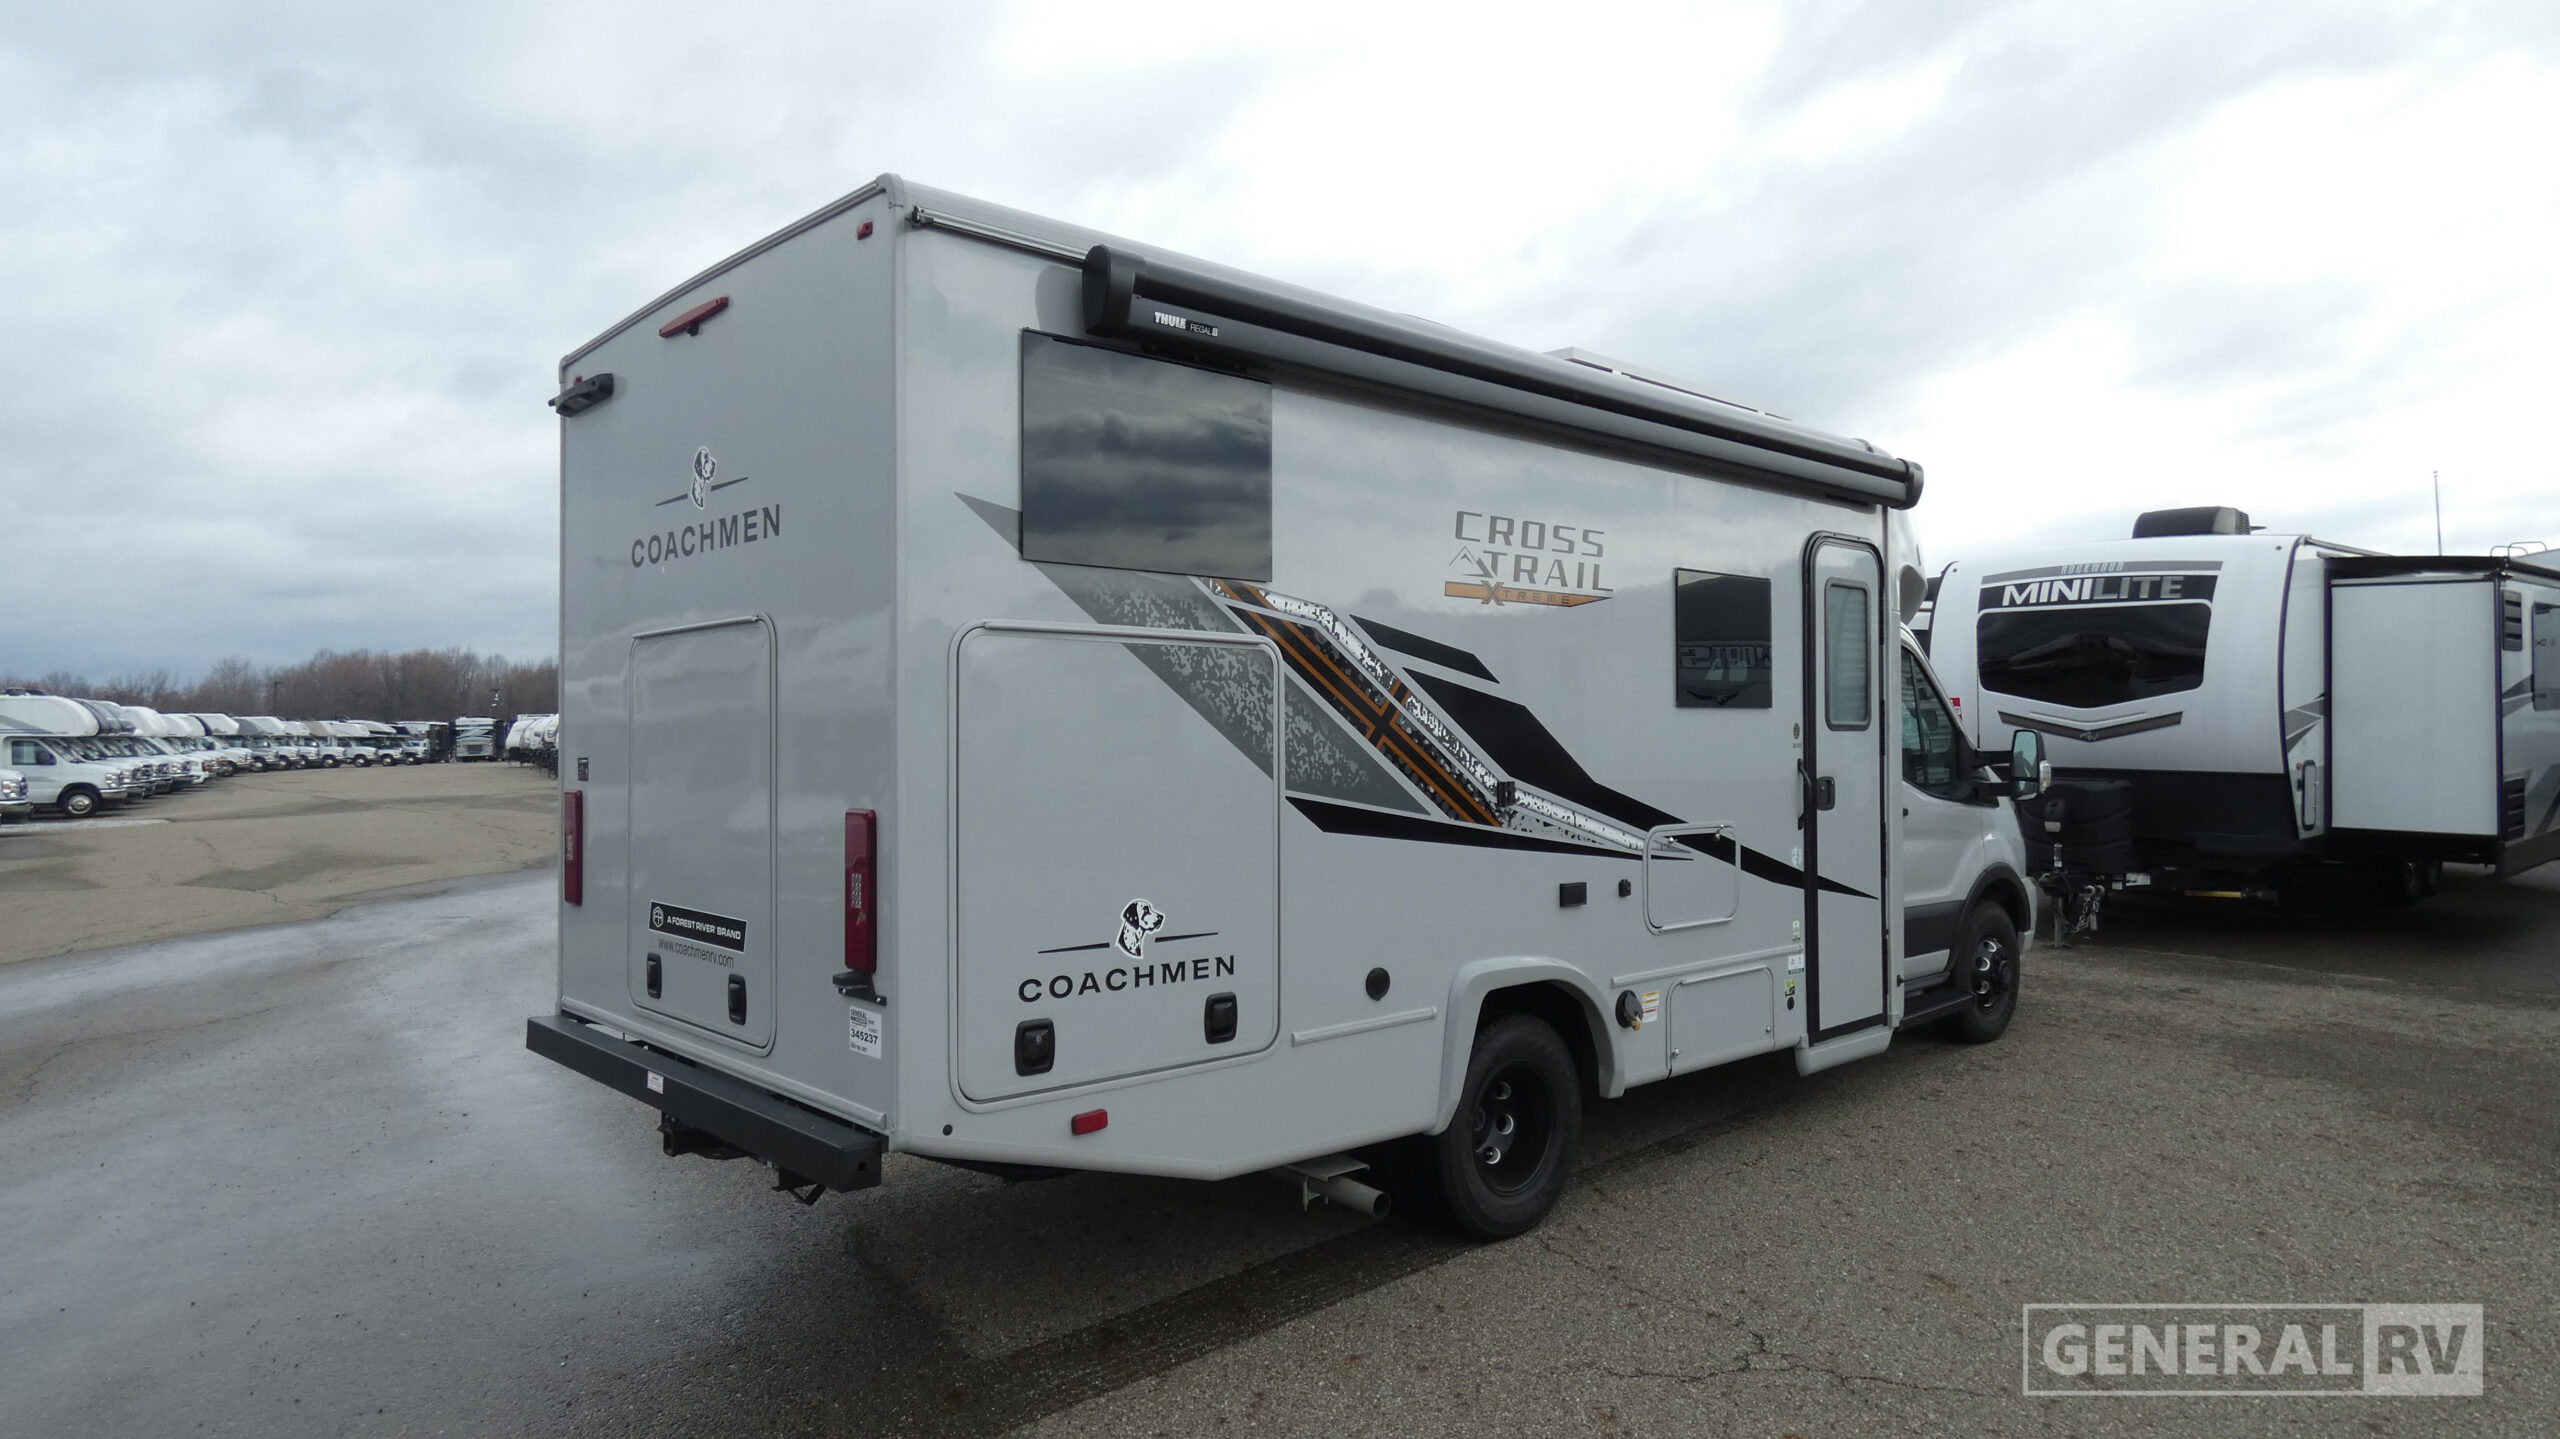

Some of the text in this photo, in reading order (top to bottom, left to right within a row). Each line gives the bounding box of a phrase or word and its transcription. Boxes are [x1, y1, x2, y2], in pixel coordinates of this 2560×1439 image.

[1154, 311, 1187, 330] THULE
[1190, 323, 1212, 336] REGAL
[631, 504, 781, 568] COACHMEN
[1455, 510, 1605, 558] CROSS
[1483, 550, 1614, 592] TRAIL
[2060, 561, 2124, 575] ROCKWOOD
[1480, 579, 1571, 607] XTREME
[667, 915, 672, 924] A
[672, 916, 696, 929] FOREST
[716, 926, 741, 940] BRAND
[658, 938, 735, 969] www.coachmenrv.com
[1018, 954, 1235, 1003] COACHMEN
[850, 1028, 878, 1045] 345237
